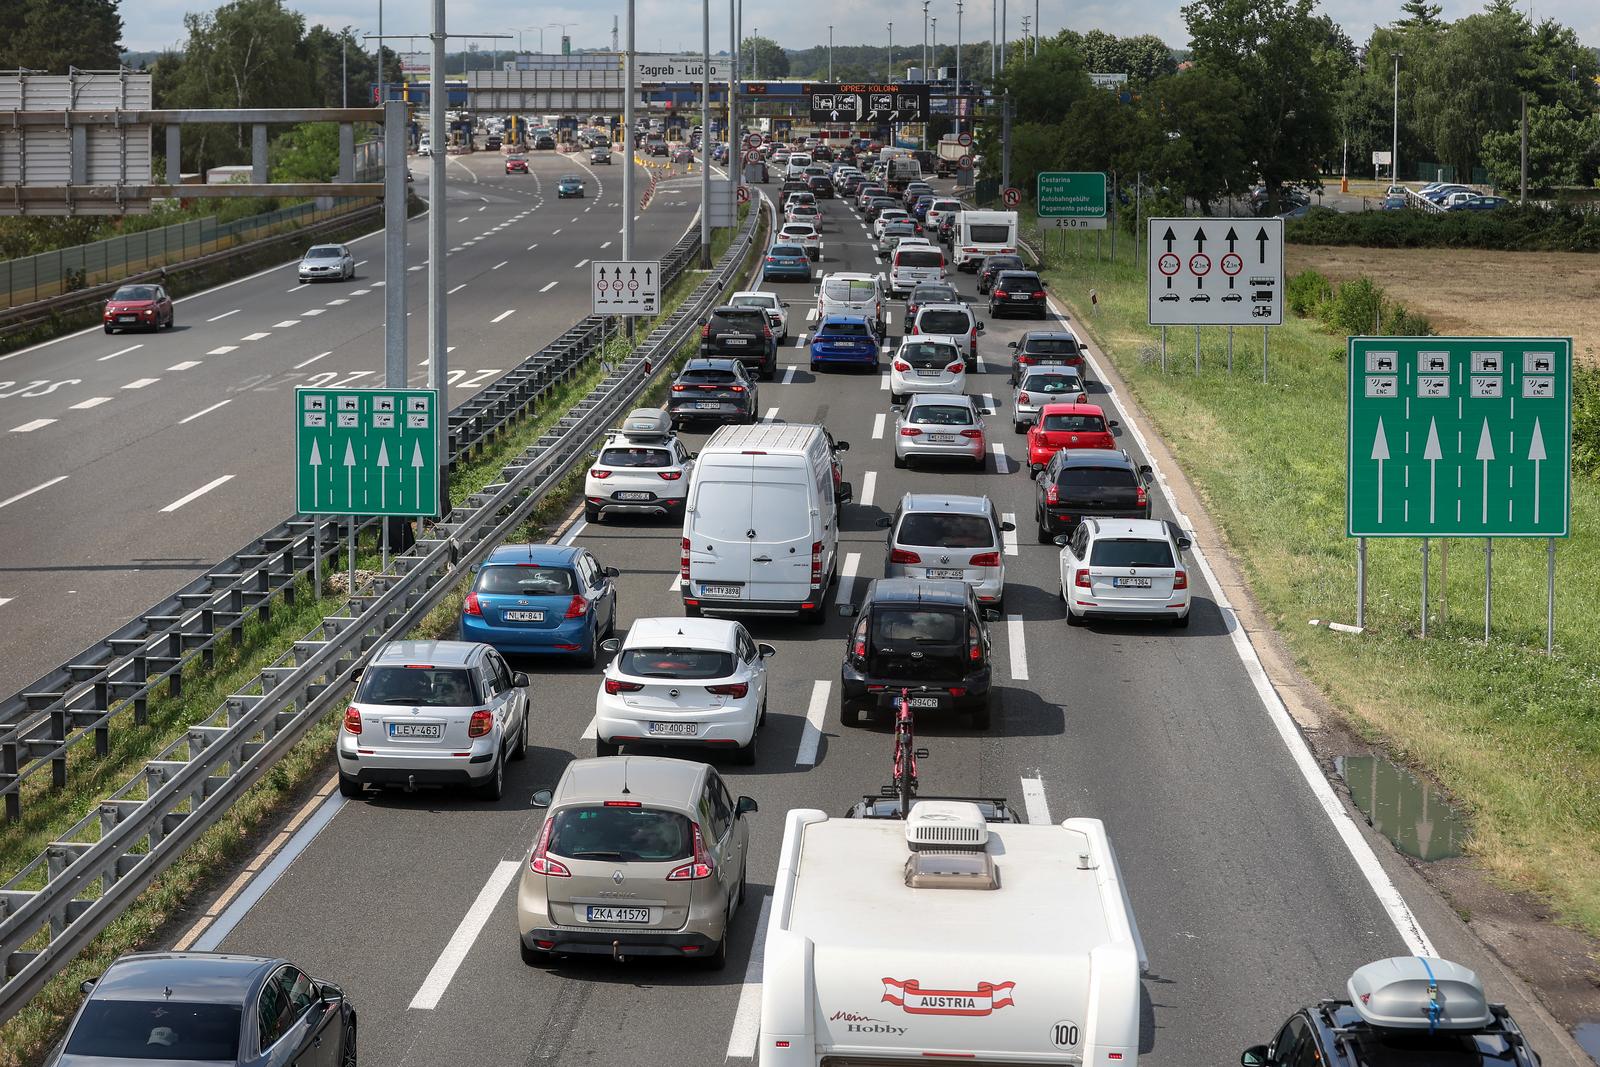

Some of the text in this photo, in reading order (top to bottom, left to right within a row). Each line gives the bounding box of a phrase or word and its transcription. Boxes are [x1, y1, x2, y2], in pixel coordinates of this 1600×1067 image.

[639, 64, 674, 77] Zagreb
[685, 64, 716, 75] Lučo
[841, 85, 899, 93] OPREZ KOLONA
[1041, 195, 1090, 204] Autobahngebühr
[1041, 205, 1104, 214] Pagamento pedaggio
[508, 611, 542, 620] NLW-841
[396, 725, 438, 735] LEY-463
[593, 908, 648, 920] ZKA 41579
[920, 996, 976, 1008] AUSTRIA
[848, 1023, 908, 1036] Hobby
[1054, 1024, 1078, 1045] 100
